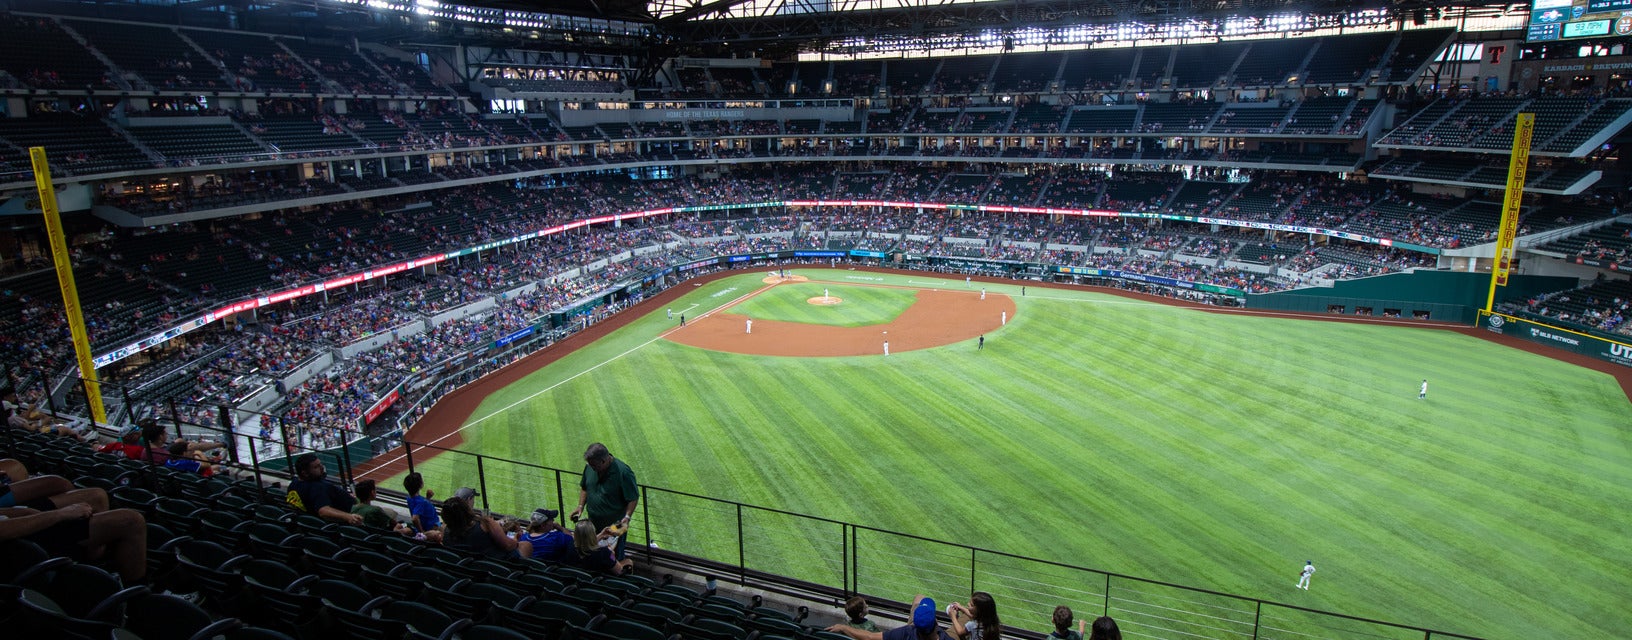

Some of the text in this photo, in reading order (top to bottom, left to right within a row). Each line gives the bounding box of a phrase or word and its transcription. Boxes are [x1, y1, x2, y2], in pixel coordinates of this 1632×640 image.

[1488, 45, 1506, 64] T
[1539, 331, 1580, 346] MLB NETWORK
